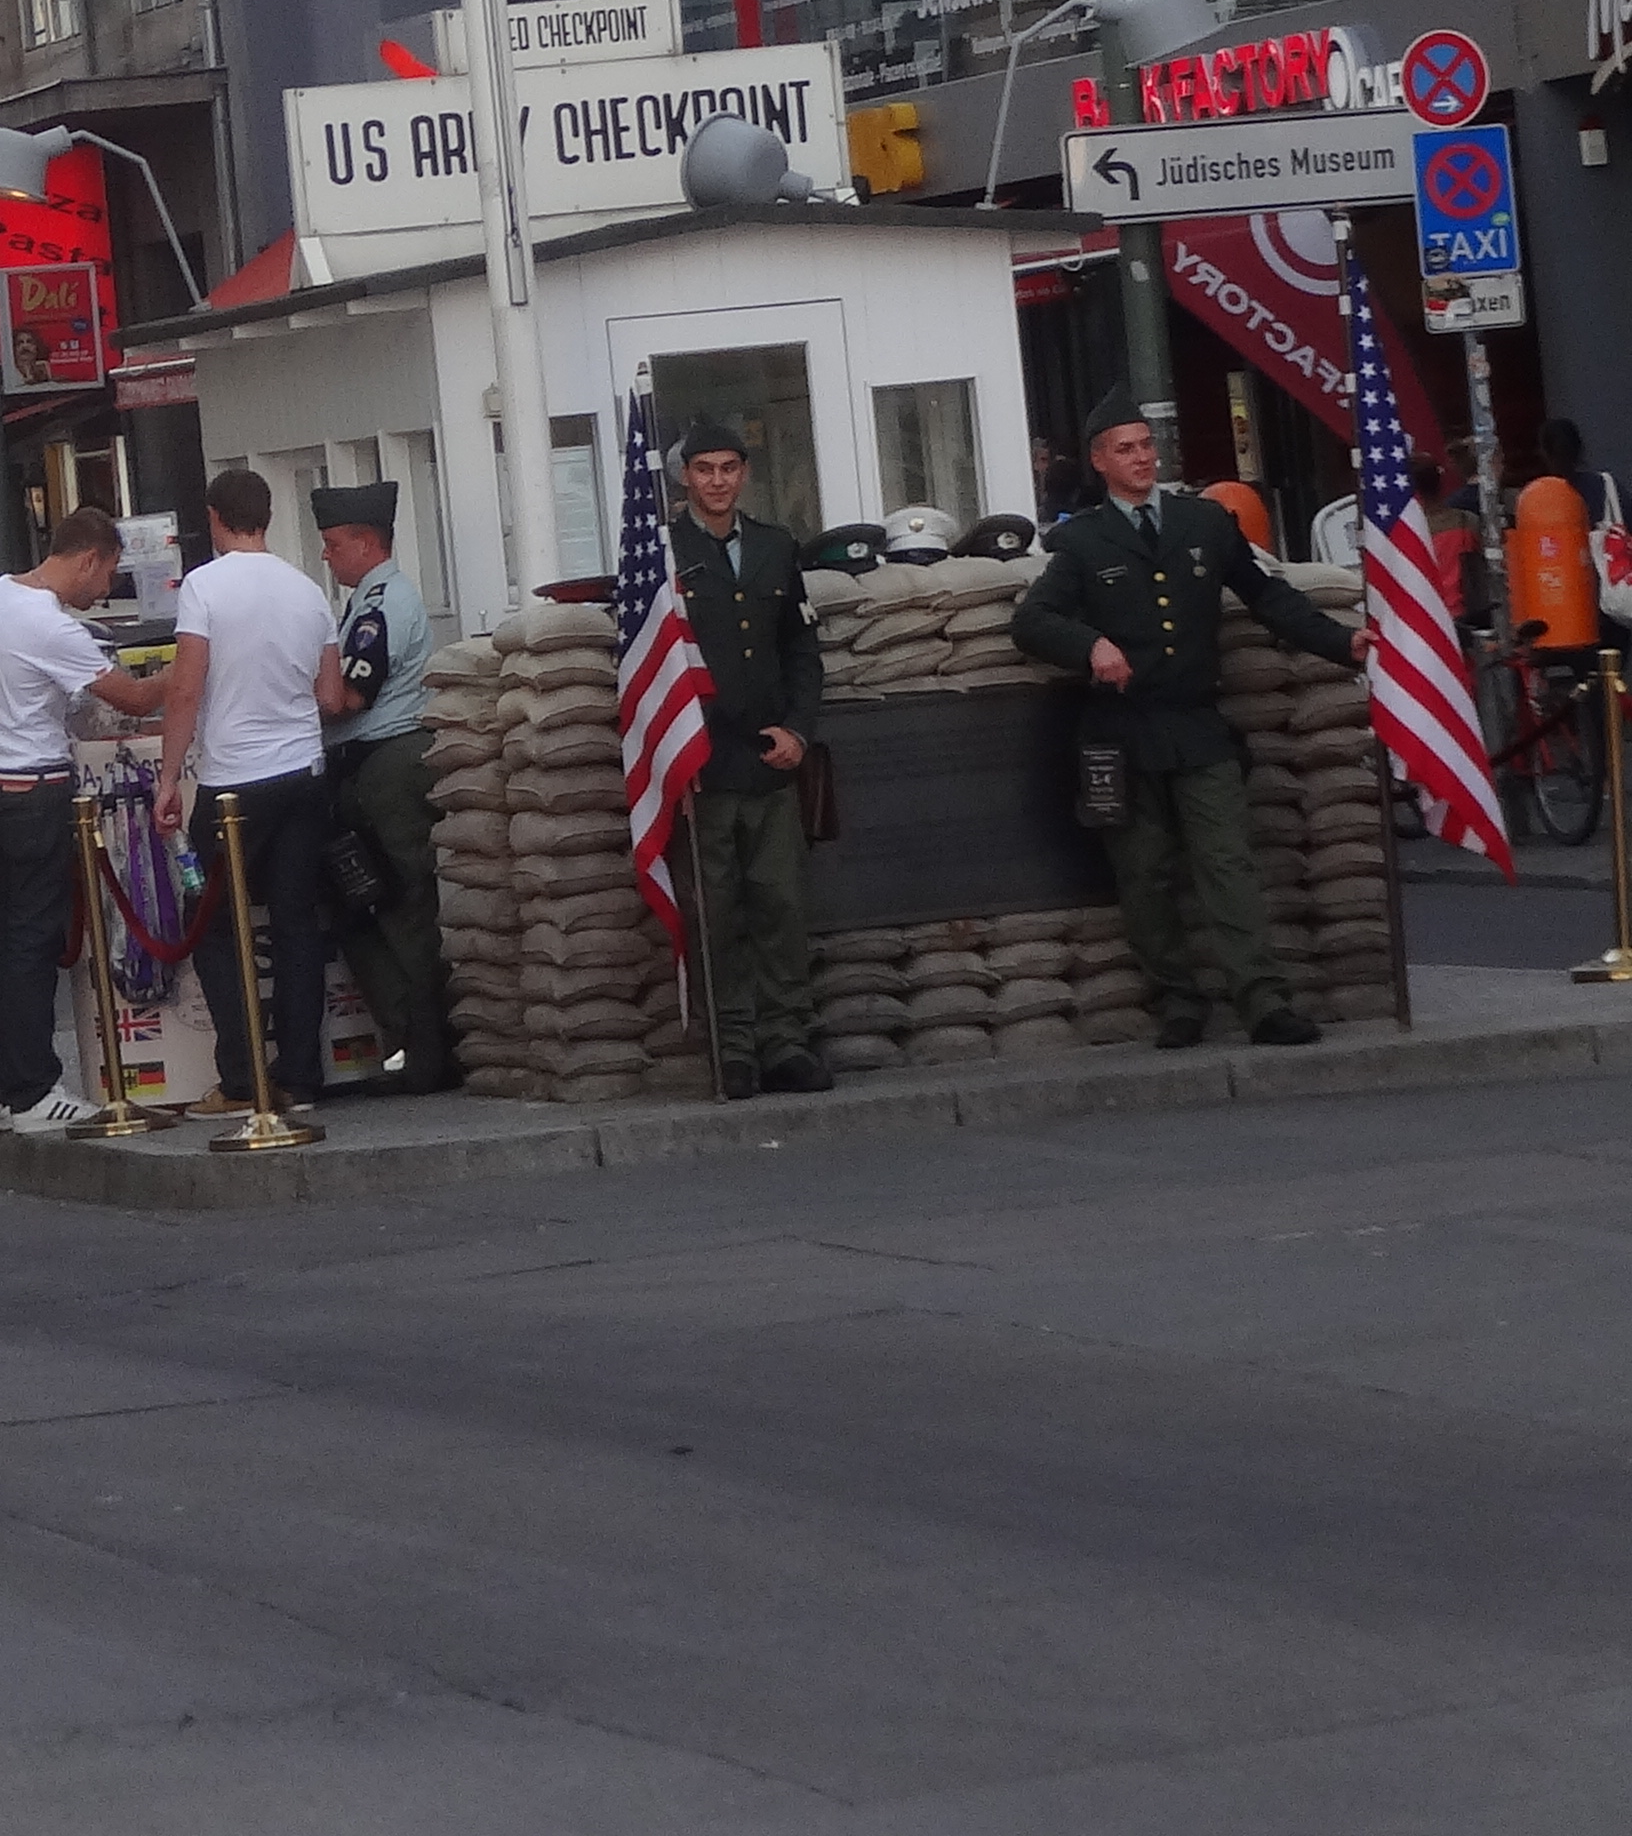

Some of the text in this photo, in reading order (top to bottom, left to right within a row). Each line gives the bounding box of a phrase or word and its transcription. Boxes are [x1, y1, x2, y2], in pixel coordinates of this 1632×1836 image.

[536, 5, 649, 50] CHECKPOINT
[324, 118, 390, 187] US
[1156, 145, 1396, 187] Jüdisches Museum
